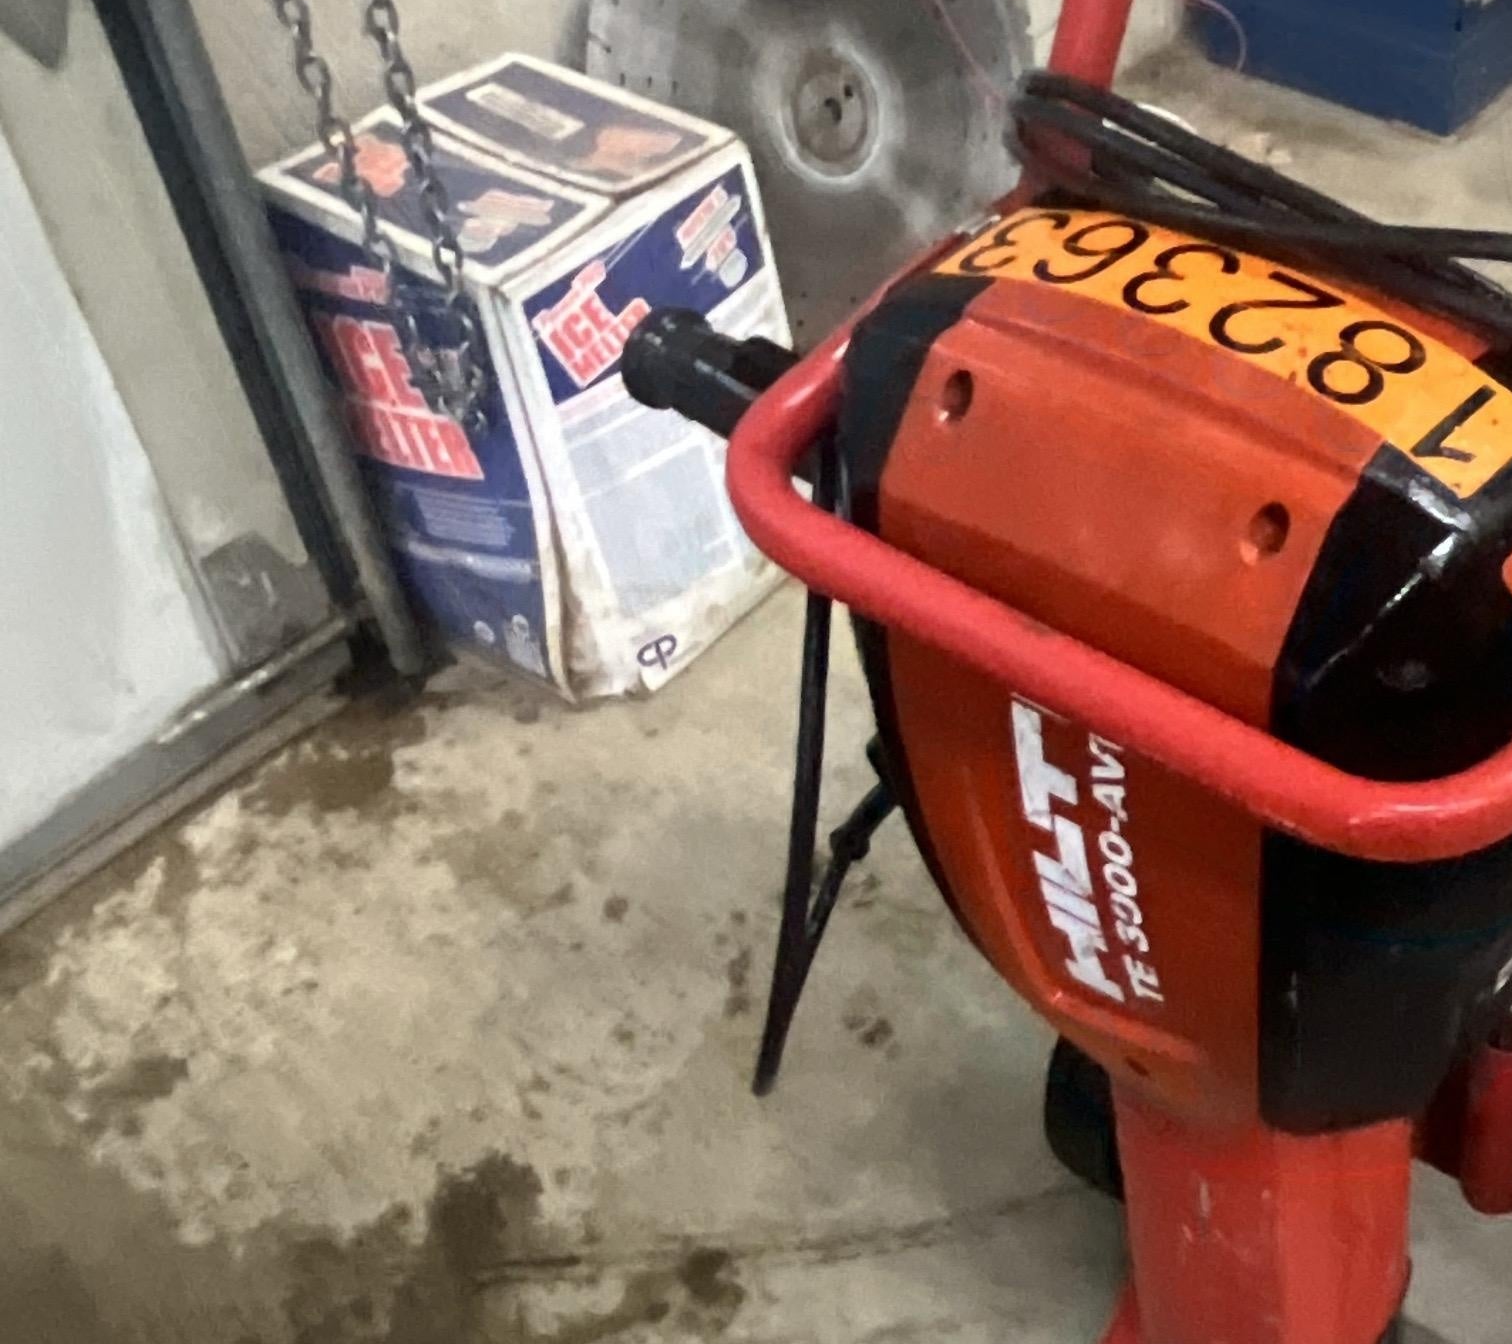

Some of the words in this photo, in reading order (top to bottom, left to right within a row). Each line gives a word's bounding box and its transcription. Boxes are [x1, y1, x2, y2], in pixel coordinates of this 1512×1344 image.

[548, 292, 614, 360] ICE
[958, 211, 1498, 462] 182363
[1011, 691, 1126, 1003] HILT
[1122, 953, 1165, 1003] TE
